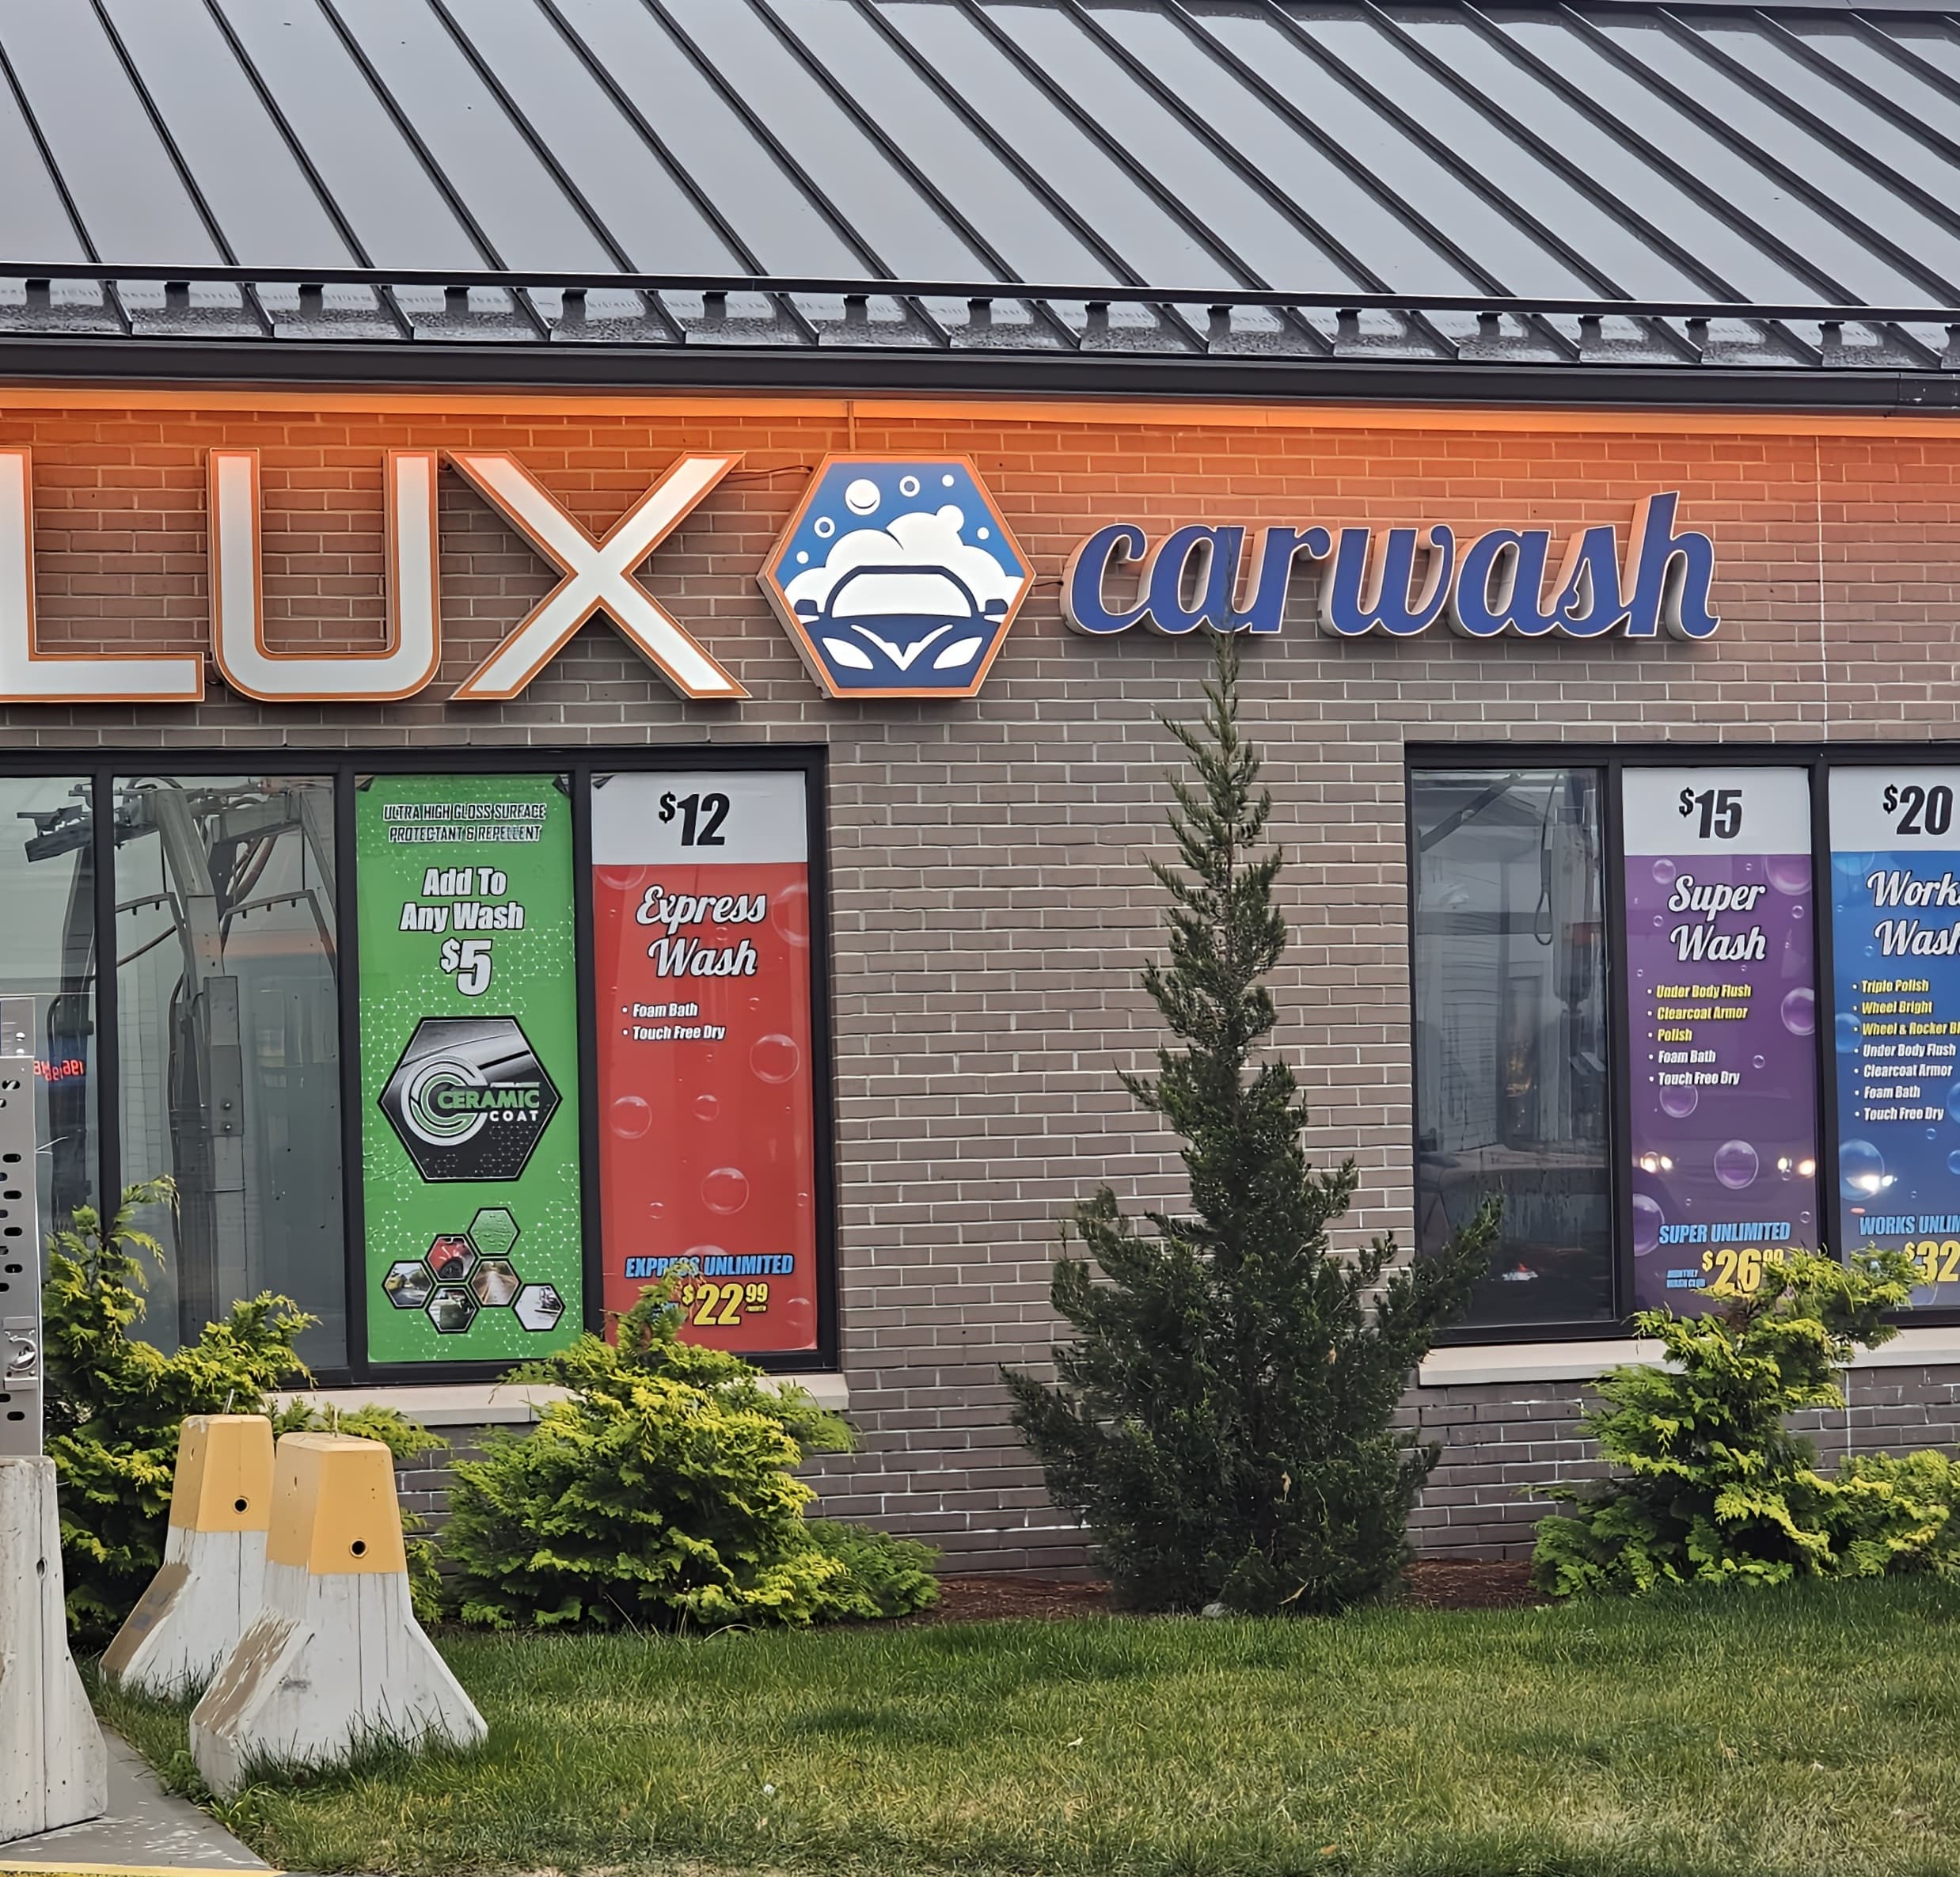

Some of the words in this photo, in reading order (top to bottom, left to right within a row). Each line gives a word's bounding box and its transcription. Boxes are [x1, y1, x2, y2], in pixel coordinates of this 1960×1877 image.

[0, 445, 753, 702] LUX
[1065, 490, 1722, 640] carwash
[383, 804, 420, 821] ULTRA
[424, 804, 450, 820] HIGH
[453, 804, 492, 820] GLOSS
[494, 804, 546, 820] SURFACE
[1678, 787, 1743, 840] $15
[1882, 784, 1954, 836] $20
[658, 792, 730, 846] $12
[389, 826, 464, 842] PROTECTANT
[477, 825, 541, 842] REPELLENT
[422, 868, 473, 896] Add
[477, 867, 507, 896] To
[1867, 870, 1960, 907] Work
[1668, 874, 1766, 921] Super
[399, 902, 450, 933] Any
[453, 901, 525, 930] Wash
[636, 884, 767, 935] Express
[1669, 924, 1767, 961] Wash
[648, 937, 758, 977] Wash
[439, 937, 492, 996] $5
[1657, 985, 1691, 997] Under
[1692, 985, 1720, 998] Body
[1721, 984, 1751, 997] Flush
[1862, 980, 1893, 994] Triple
[1895, 979, 1929, 992] Polish
[633, 1004, 667, 1017] Foam
[669, 1003, 698, 1016] Bath
[1657, 1007, 1711, 1020] Clearcoat
[1713, 1006, 1748, 1019] Armor
[1862, 1001, 1897, 1014] Wheel
[1898, 1001, 1932, 1014] Bright
[633, 1025, 671, 1039] Touch
[674, 1026, 701, 1039] Free
[704, 1026, 725, 1039] Dry
[1658, 1028, 1692, 1042] Polish
[1863, 1023, 1897, 1035] Wheel
[1909, 1022, 1947, 1035] Rocker
[1658, 1051, 1688, 1063] Foam
[1690, 1050, 1716, 1062] Bath
[1863, 1044, 1896, 1057] Under
[1897, 1043, 1925, 1057] Body
[1927, 1043, 1956, 1056] Flush
[1658, 1072, 1692, 1085] Touch
[1694, 1071, 1719, 1085] Free
[1720, 1071, 1740, 1085] Dry
[1863, 1065, 1917, 1077] Clearcoat
[1919, 1064, 1953, 1077] Armor
[437, 1090, 540, 1108] CERAMIC
[1864, 1086, 1894, 1099] Foam
[1895, 1085, 1920, 1098] Bath
[489, 1111, 538, 1122] COAT
[1864, 1108, 1897, 1121] Touch
[1899, 1107, 1924, 1120] Free
[1924, 1107, 1944, 1121] Dry
[1658, 1224, 1707, 1244] SUPER
[1711, 1222, 1791, 1242] UNLIMITED
[1859, 1216, 1915, 1235] WORKS
[704, 1254, 794, 1276] UNLIMITED
